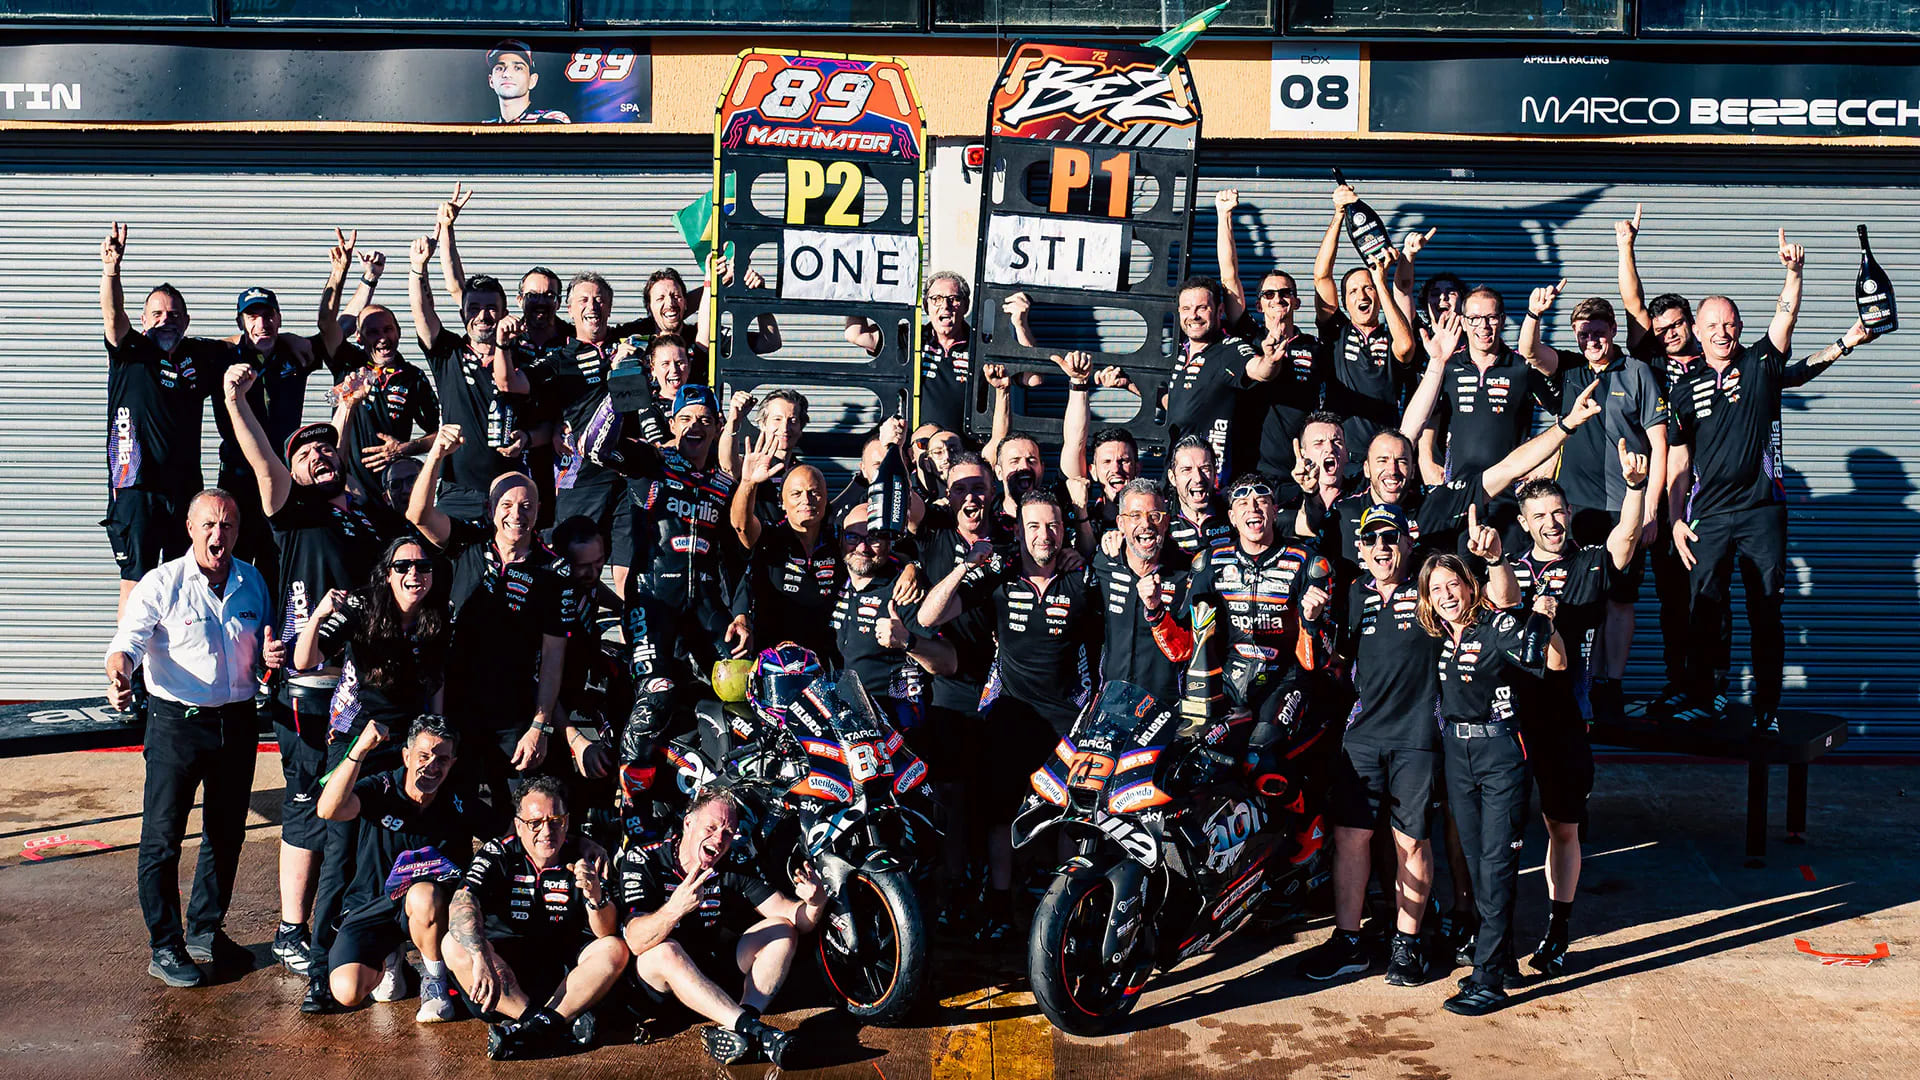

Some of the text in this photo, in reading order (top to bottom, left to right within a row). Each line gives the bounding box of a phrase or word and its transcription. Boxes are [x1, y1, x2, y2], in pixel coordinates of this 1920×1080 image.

[566, 47, 638, 82] 89
[1092, 51, 1107, 61] 72
[1300, 55, 1330, 64] BOX
[1523, 54, 1610, 65] APRILIA RACING
[760, 68, 875, 123] 89
[1280, 75, 1349, 109] 08
[620, 104, 639, 113] SPA
[1521, 96, 1680, 125] MARCO
[748, 124, 892, 152] MARTINATOR
[1049, 147, 1131, 218] P1
[786, 159, 865, 227] P2
[790, 245, 899, 286] ONE
[1486, 377, 1510, 386] aprilia
[117, 406, 133, 465] aprilia
[299, 426, 328, 438] aprilia
[1770, 420, 1783, 480] aprilia
[666, 496, 719, 524] aprilia
[892, 491, 902, 523] PROSECCO
[1205, 527, 1230, 536] aprilia
[813, 557, 834, 567] aprilia
[507, 568, 534, 584] aprilia
[859, 596, 881, 606] aprilia
[1045, 595, 1069, 605] aprilia
[1258, 603, 1288, 611] TARGA
[1230, 614, 1283, 631] aprilia
[630, 607, 656, 675] aprilia
[1460, 641, 1482, 651] aprilia
[1278, 690, 1302, 725] aprilia
[731, 717, 754, 737] aprilia
[1205, 724, 1230, 745] aprilia
[1078, 739, 1112, 752] TARGA
[848, 741, 897, 784] 89
[1066, 751, 1117, 790] 72
[809, 776, 849, 800] sterilgarda
[800, 797, 823, 815] sky
[381, 815, 404, 831] 89
[1140, 811, 1162, 824] sky
[543, 879, 569, 890] aprilia
